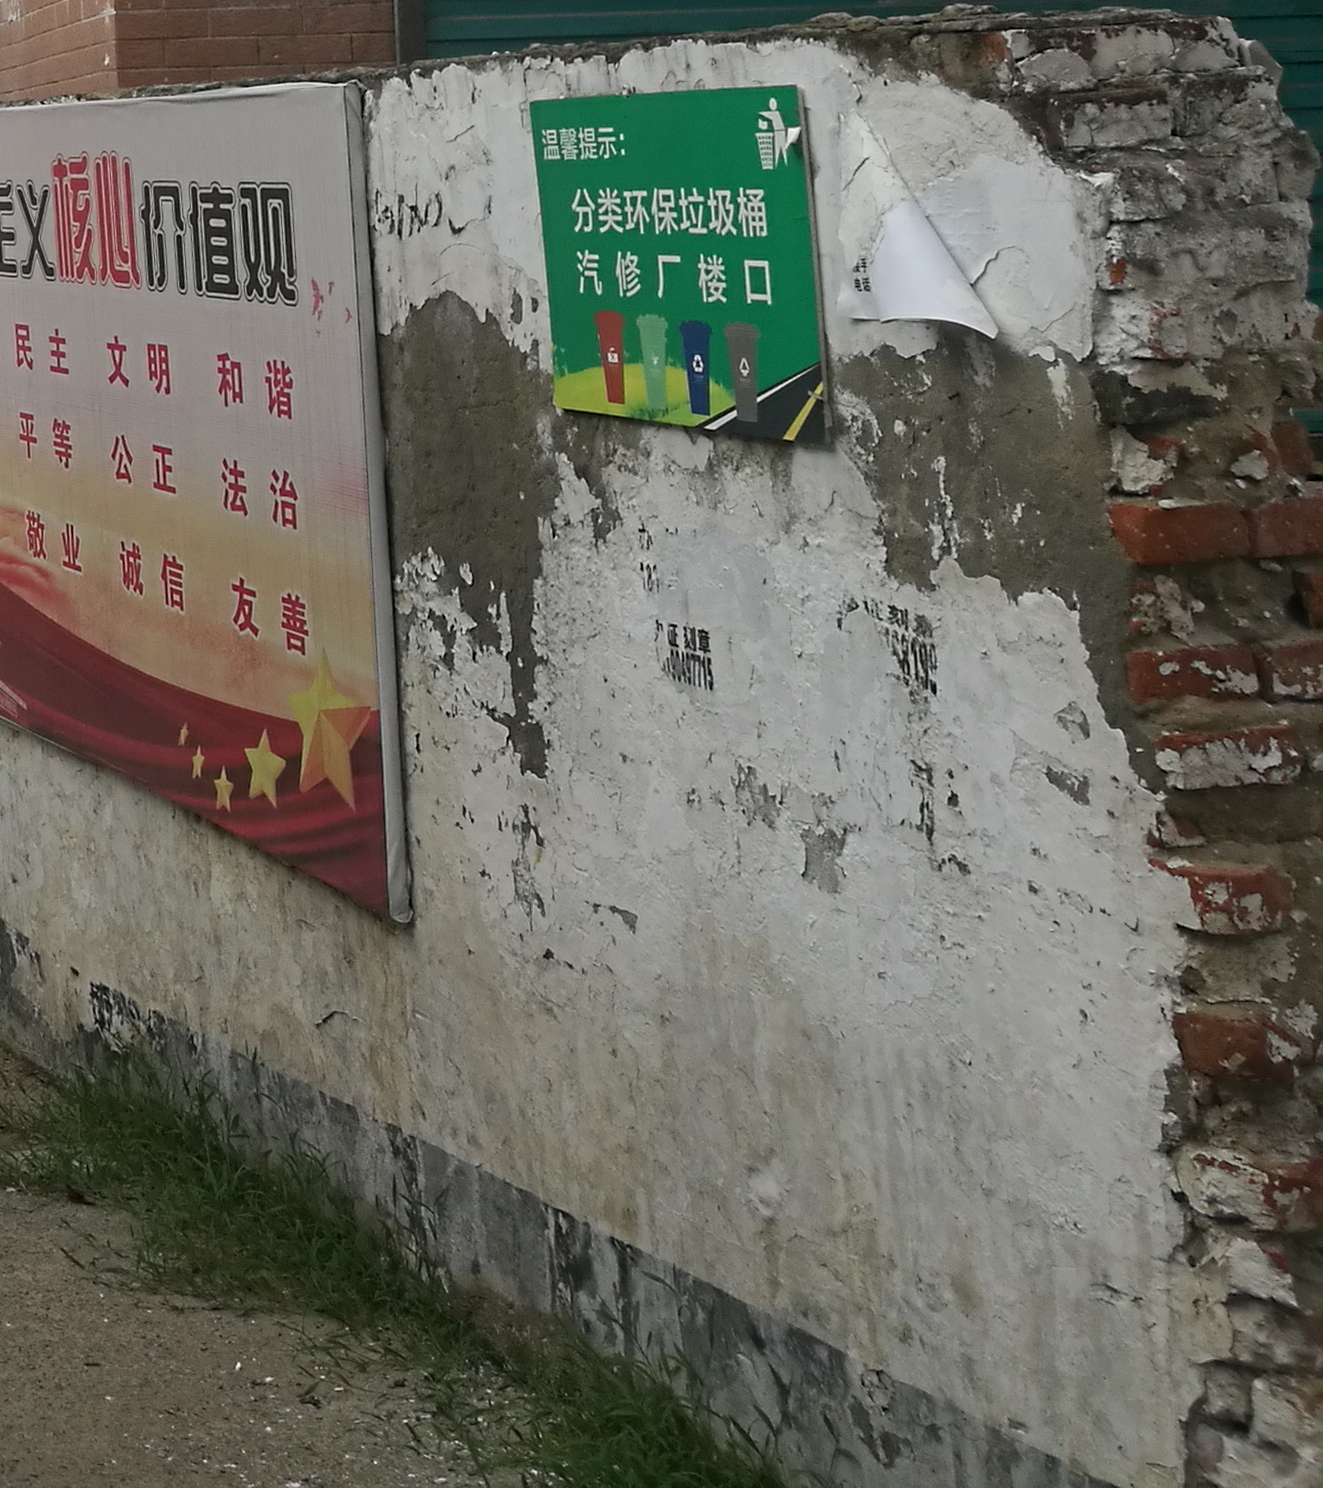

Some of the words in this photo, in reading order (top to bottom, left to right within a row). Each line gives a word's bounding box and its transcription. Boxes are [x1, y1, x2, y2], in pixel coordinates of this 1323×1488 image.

[571, 186, 769, 238] 分类环保垃圾桶
[15, 323, 69, 376] 民主
[107, 335, 172, 395] 文明
[217, 352, 293, 420] 和谐
[19, 412, 73, 469] 平等
[111, 434, 176, 495] 公正
[221, 459, 298, 530] 法治
[26, 511, 82, 573] 敬业
[120, 541, 185, 611] 诚信
[232, 578, 309, 655] 友善
